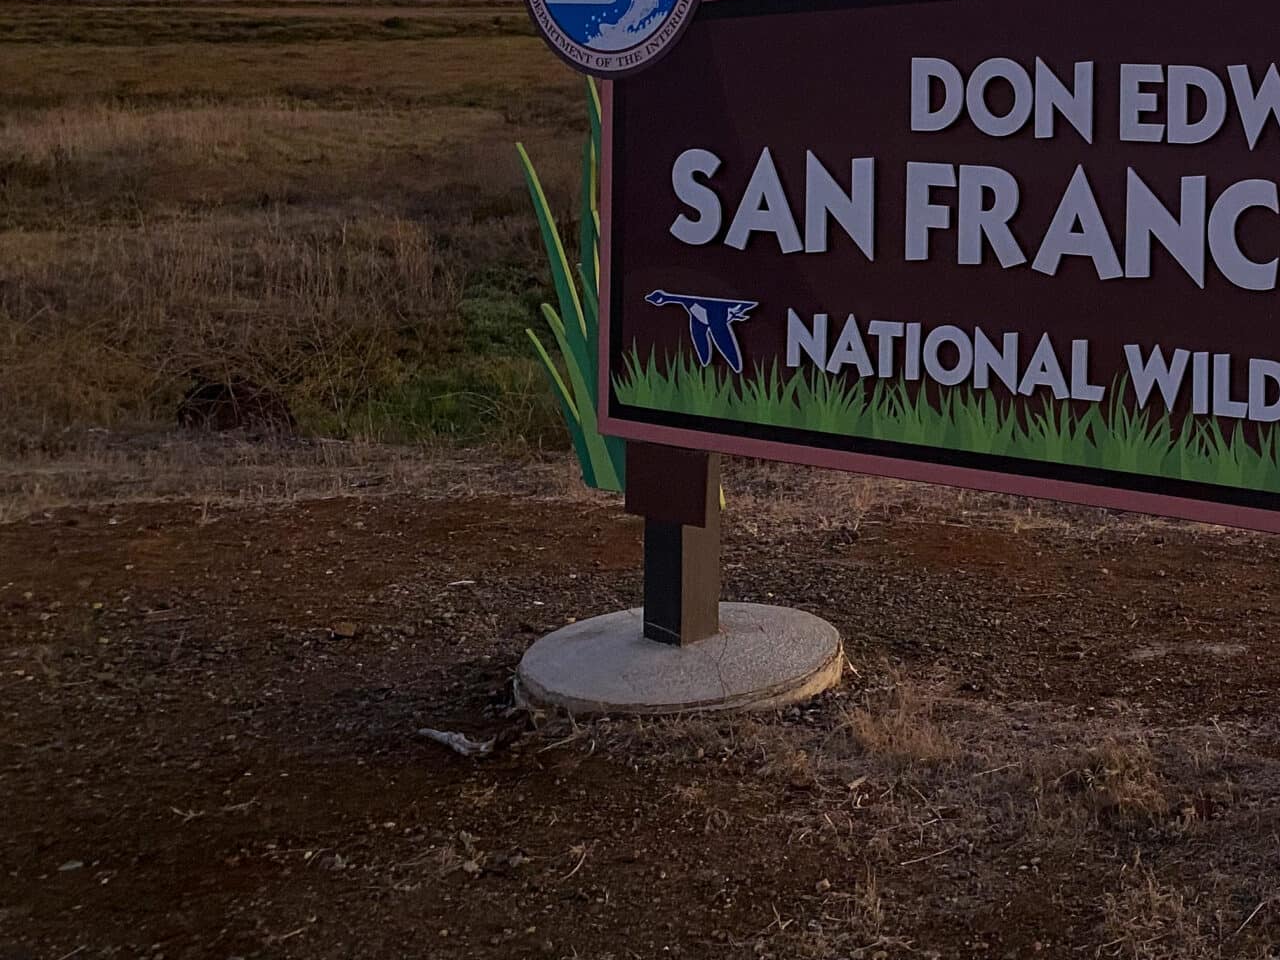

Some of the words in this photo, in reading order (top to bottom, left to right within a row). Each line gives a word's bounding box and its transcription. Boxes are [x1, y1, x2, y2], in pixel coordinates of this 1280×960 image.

[596, 57, 612, 68] OF
[616, 50, 642, 66] THE
[910, 56, 1094, 144] DON
[669, 146, 876, 261] SAN
[786, 307, 1106, 402] NATIONAL
